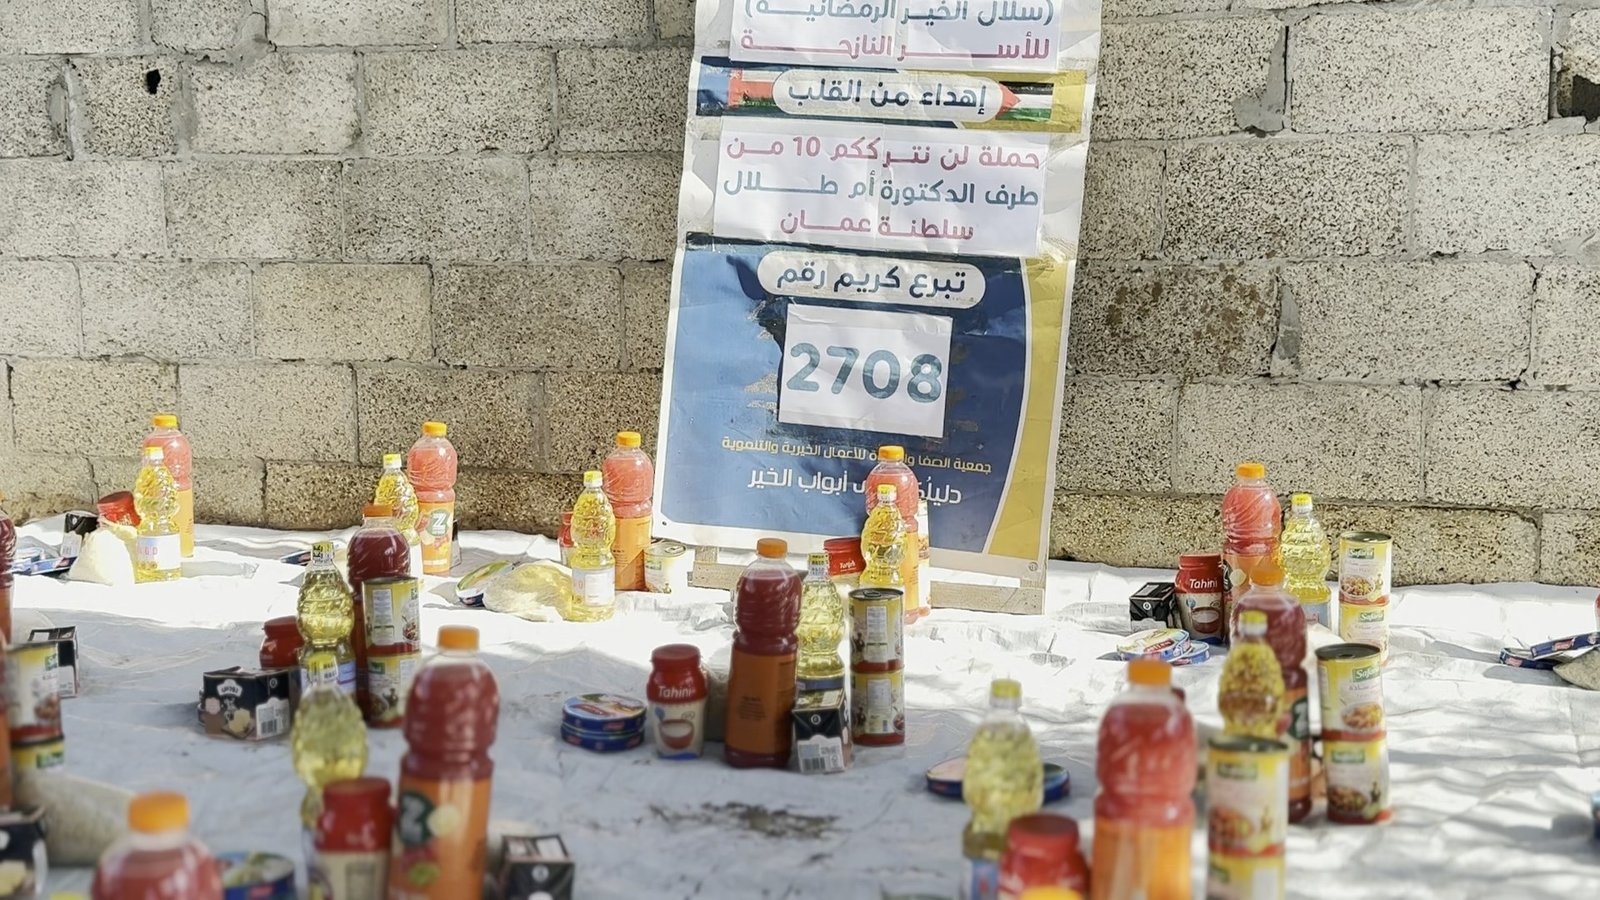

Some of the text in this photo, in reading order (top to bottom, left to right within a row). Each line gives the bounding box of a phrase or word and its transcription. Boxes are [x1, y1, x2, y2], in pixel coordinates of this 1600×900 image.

[788, 78, 986, 115] إهداء من القلب
[727, 137, 784, 159] من
[793, 136, 821, 157] 10
[979, 146, 1040, 169] حملة
[940, 145, 969, 171] لن
[724, 170, 1039, 210] طرف الدكتورة أم طلال
[780, 209, 974, 240] سلطنة عمان
[777, 261, 966, 298] تبرع كريم رقم
[786, 342, 942, 403] 2708
[722, 436, 778, 454] والتنموية
[781, 441, 820, 457] الخيرية
[823, 445, 866, 460] للأعمال
[918, 455, 950, 468] الصفا
[953, 457, 992, 475] جمعية
[747, 467, 792, 489] الخير
[798, 470, 847, 496] أبواب
[1189, 578, 1218, 589] Tahini
[658, 685, 692, 698] Tahini
